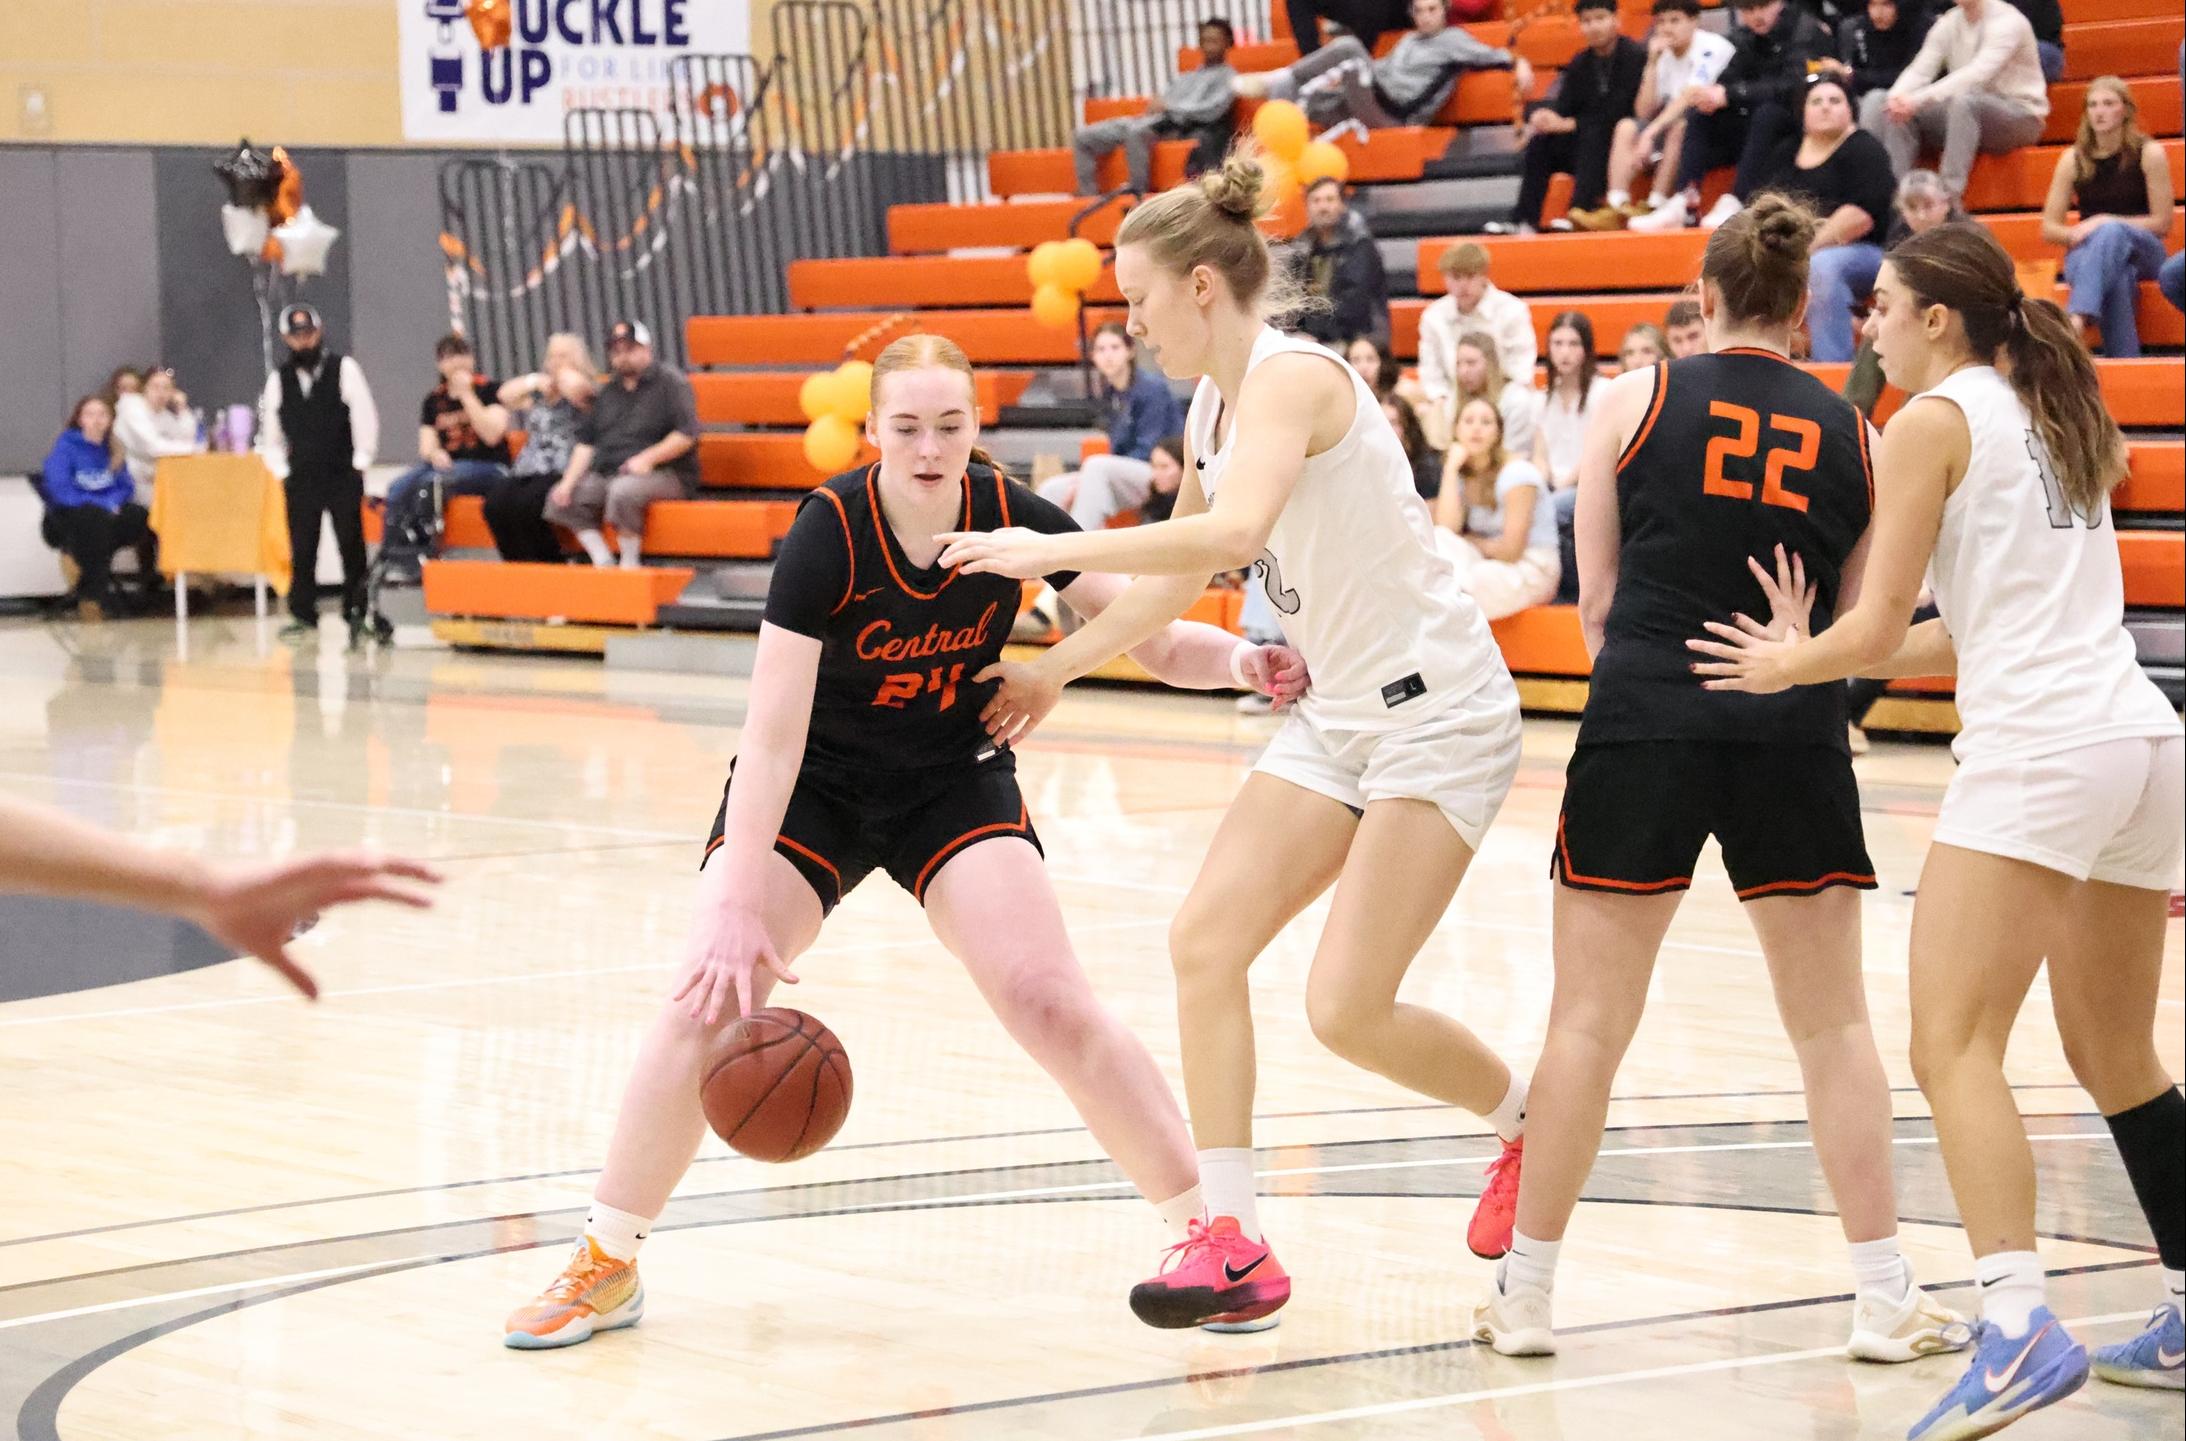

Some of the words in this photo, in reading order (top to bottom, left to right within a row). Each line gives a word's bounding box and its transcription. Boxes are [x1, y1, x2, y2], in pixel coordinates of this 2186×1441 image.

[518, 0, 690, 46] UCKLE
[481, 48, 551, 104] UP
[1703, 400, 1821, 513] 22
[2024, 429, 2103, 529] 1
[855, 601, 998, 662] Central
[871, 663, 966, 712] 24
